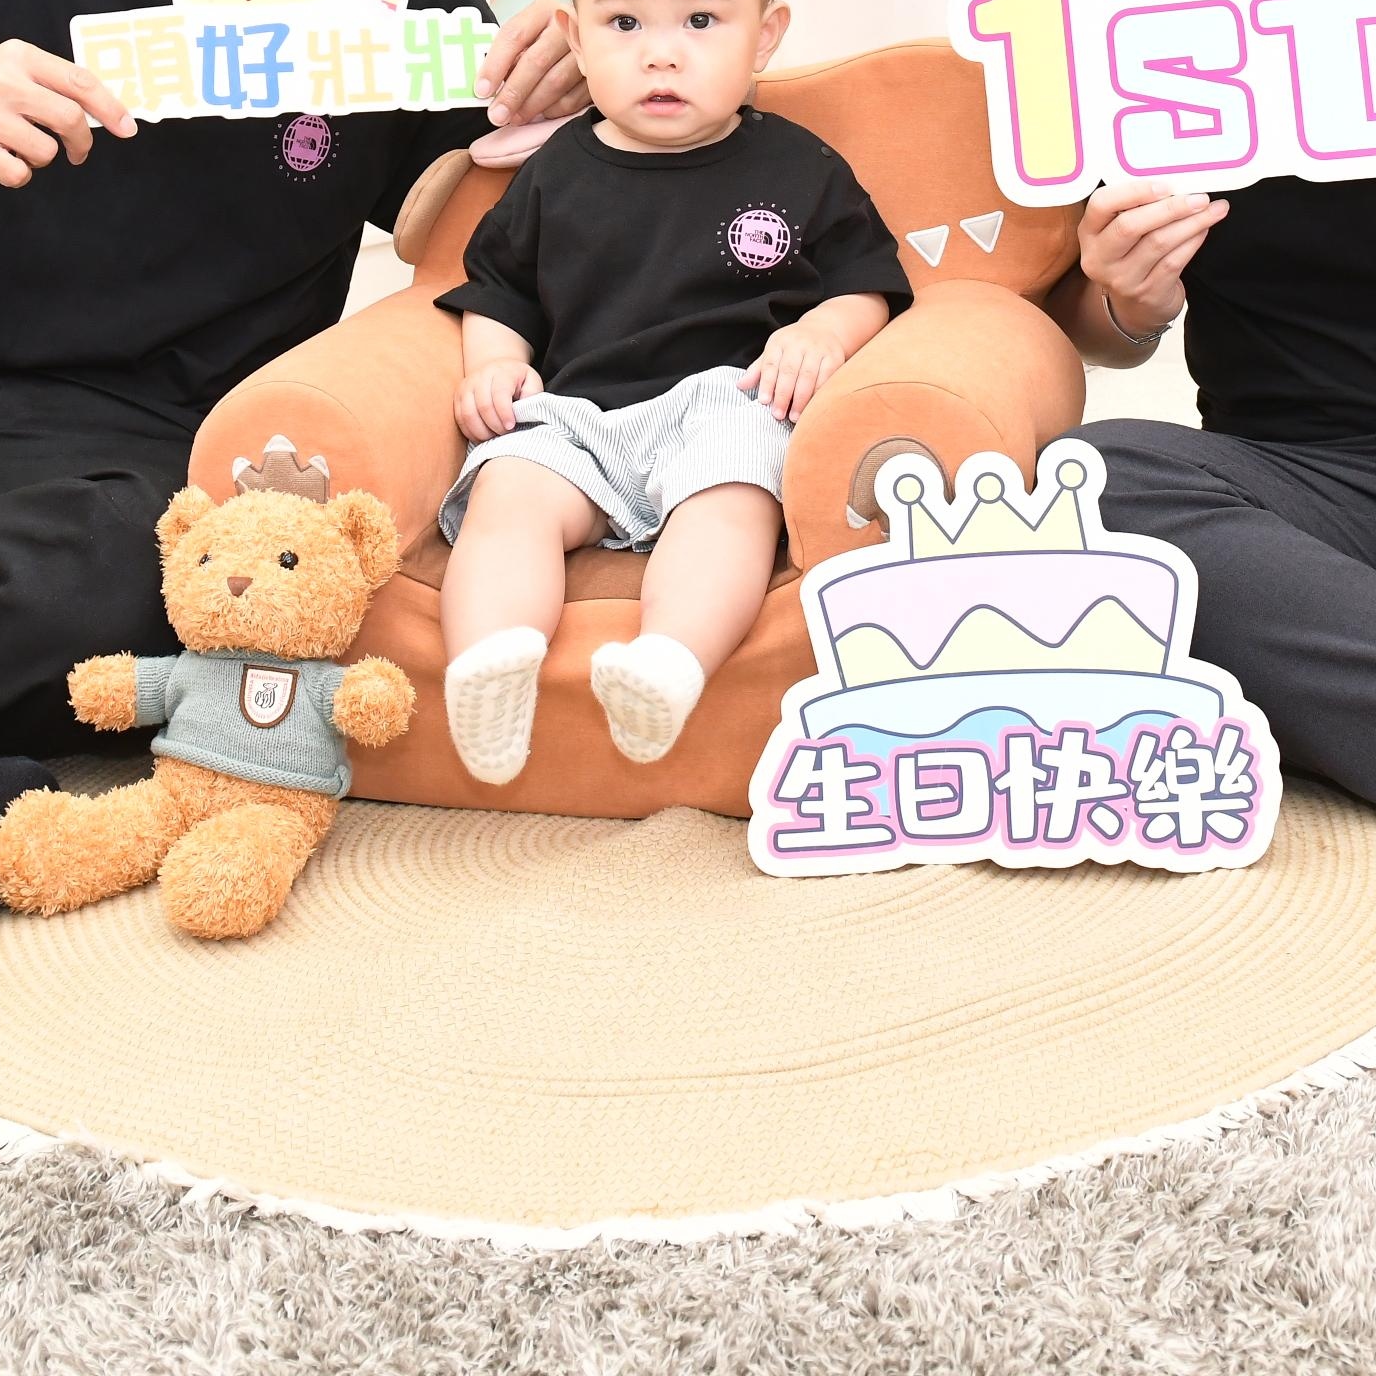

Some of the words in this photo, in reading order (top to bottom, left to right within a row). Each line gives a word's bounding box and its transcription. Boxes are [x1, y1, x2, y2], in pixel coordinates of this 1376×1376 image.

[79, 15, 493, 112] 頭好壯壯
[773, 725, 1254, 853] 生日快樂
